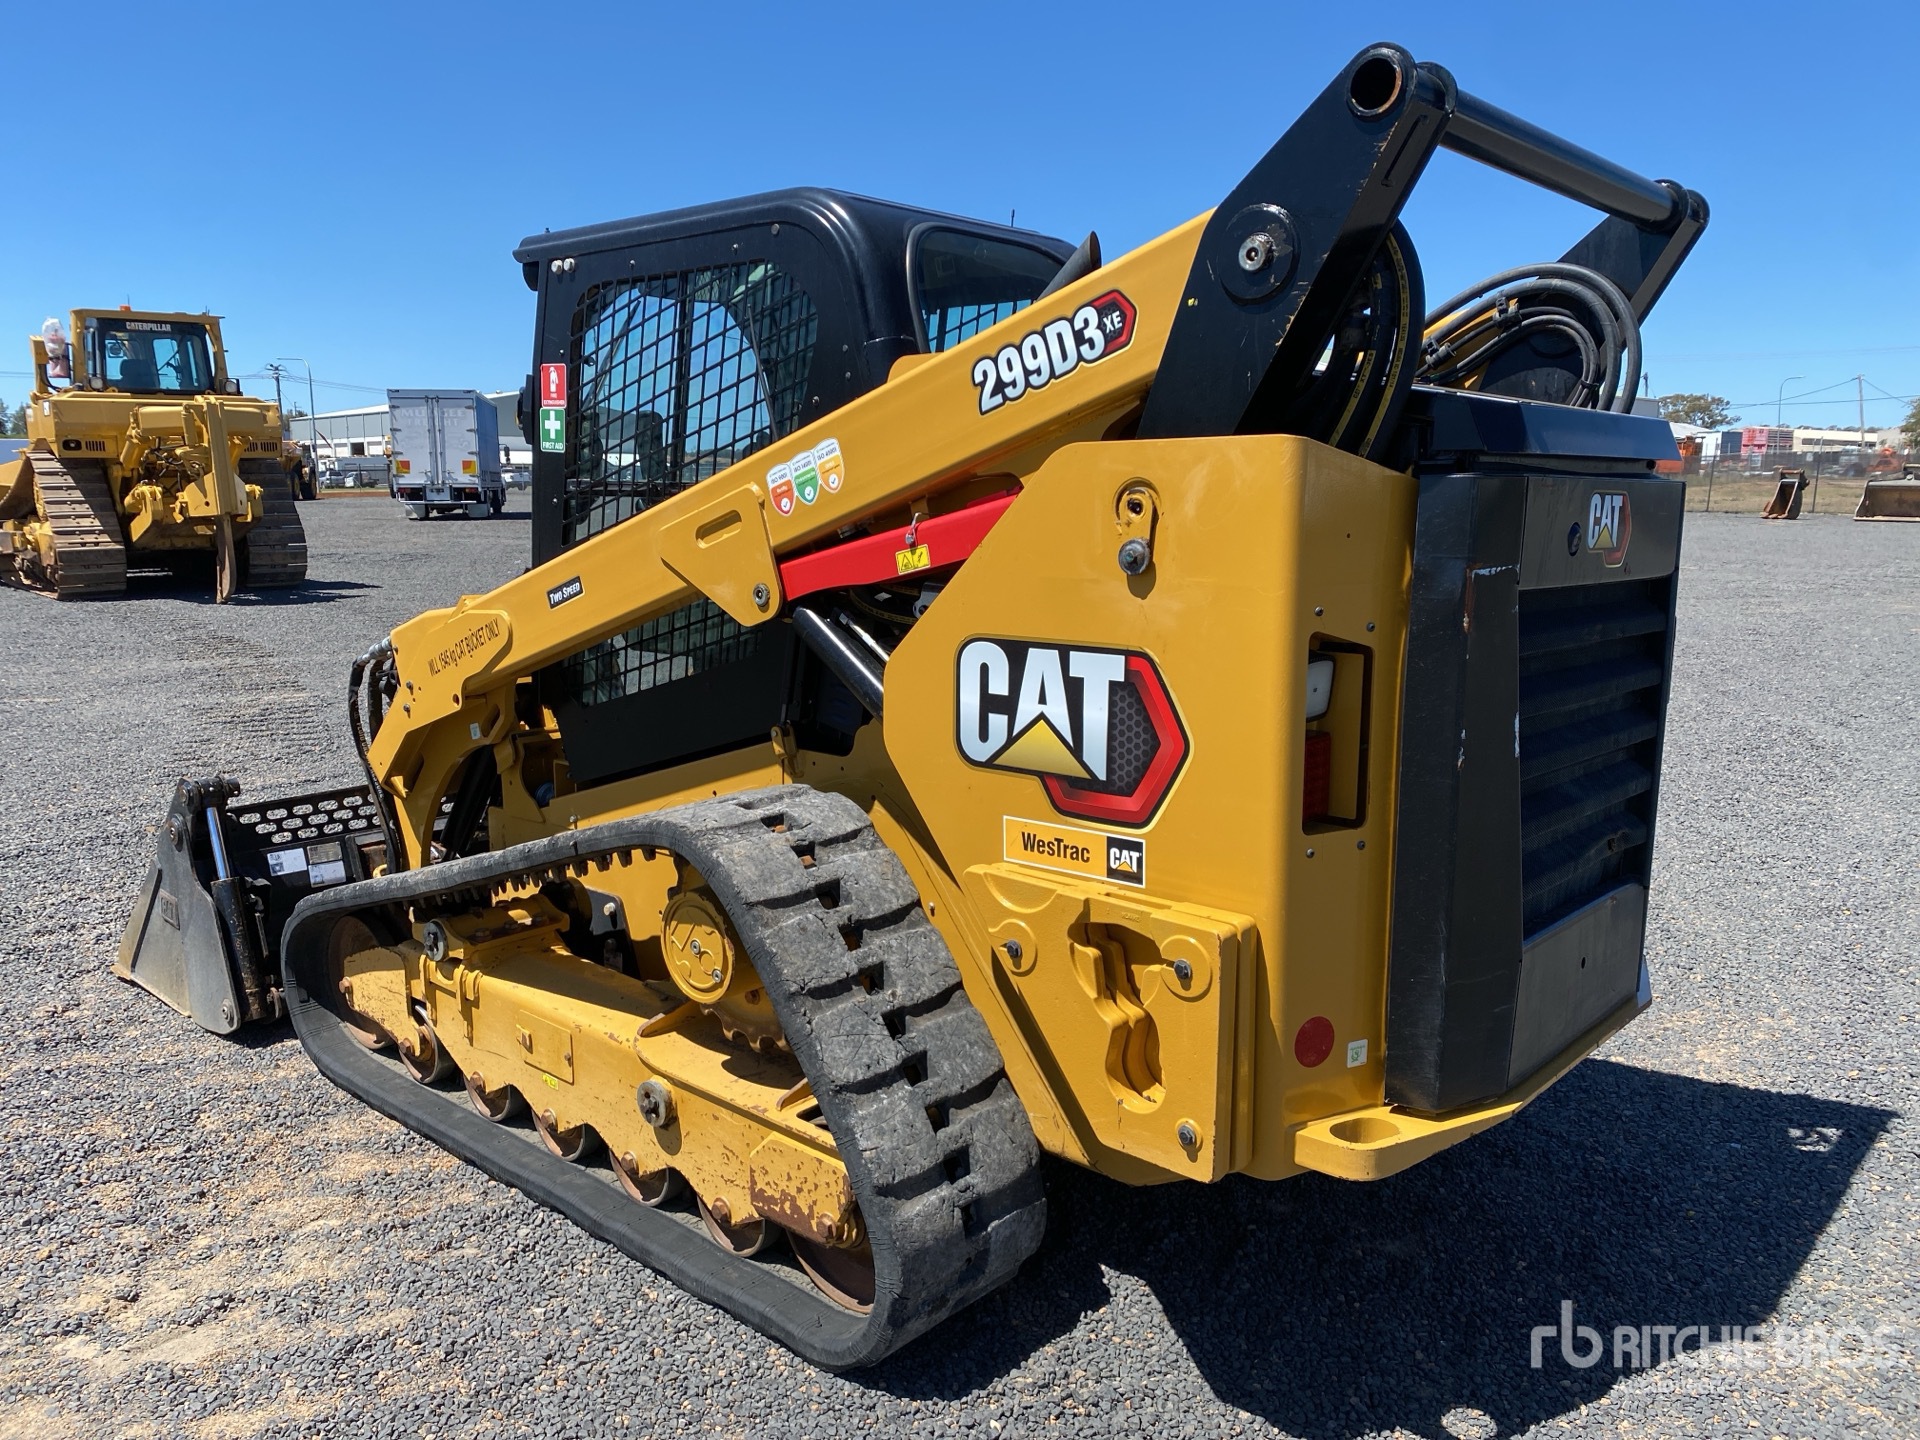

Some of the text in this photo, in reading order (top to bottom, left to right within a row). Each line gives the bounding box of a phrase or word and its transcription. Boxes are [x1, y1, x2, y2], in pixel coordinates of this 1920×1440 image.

[126, 321, 171, 331] CATERPILLAR
[974, 306, 1122, 412] 299D3 XE
[543, 441, 564, 450] FIRST AID
[1588, 493, 1623, 549] CAT
[428, 657, 440, 676] WLL
[454, 638, 466, 660] CAT
[464, 626, 487, 654] BUCKET
[484, 617, 500, 641] ONLY
[959, 641, 1125, 781] CAT
[1021, 831, 1090, 863] WesTrac
[1109, 847, 1140, 873] CAT
